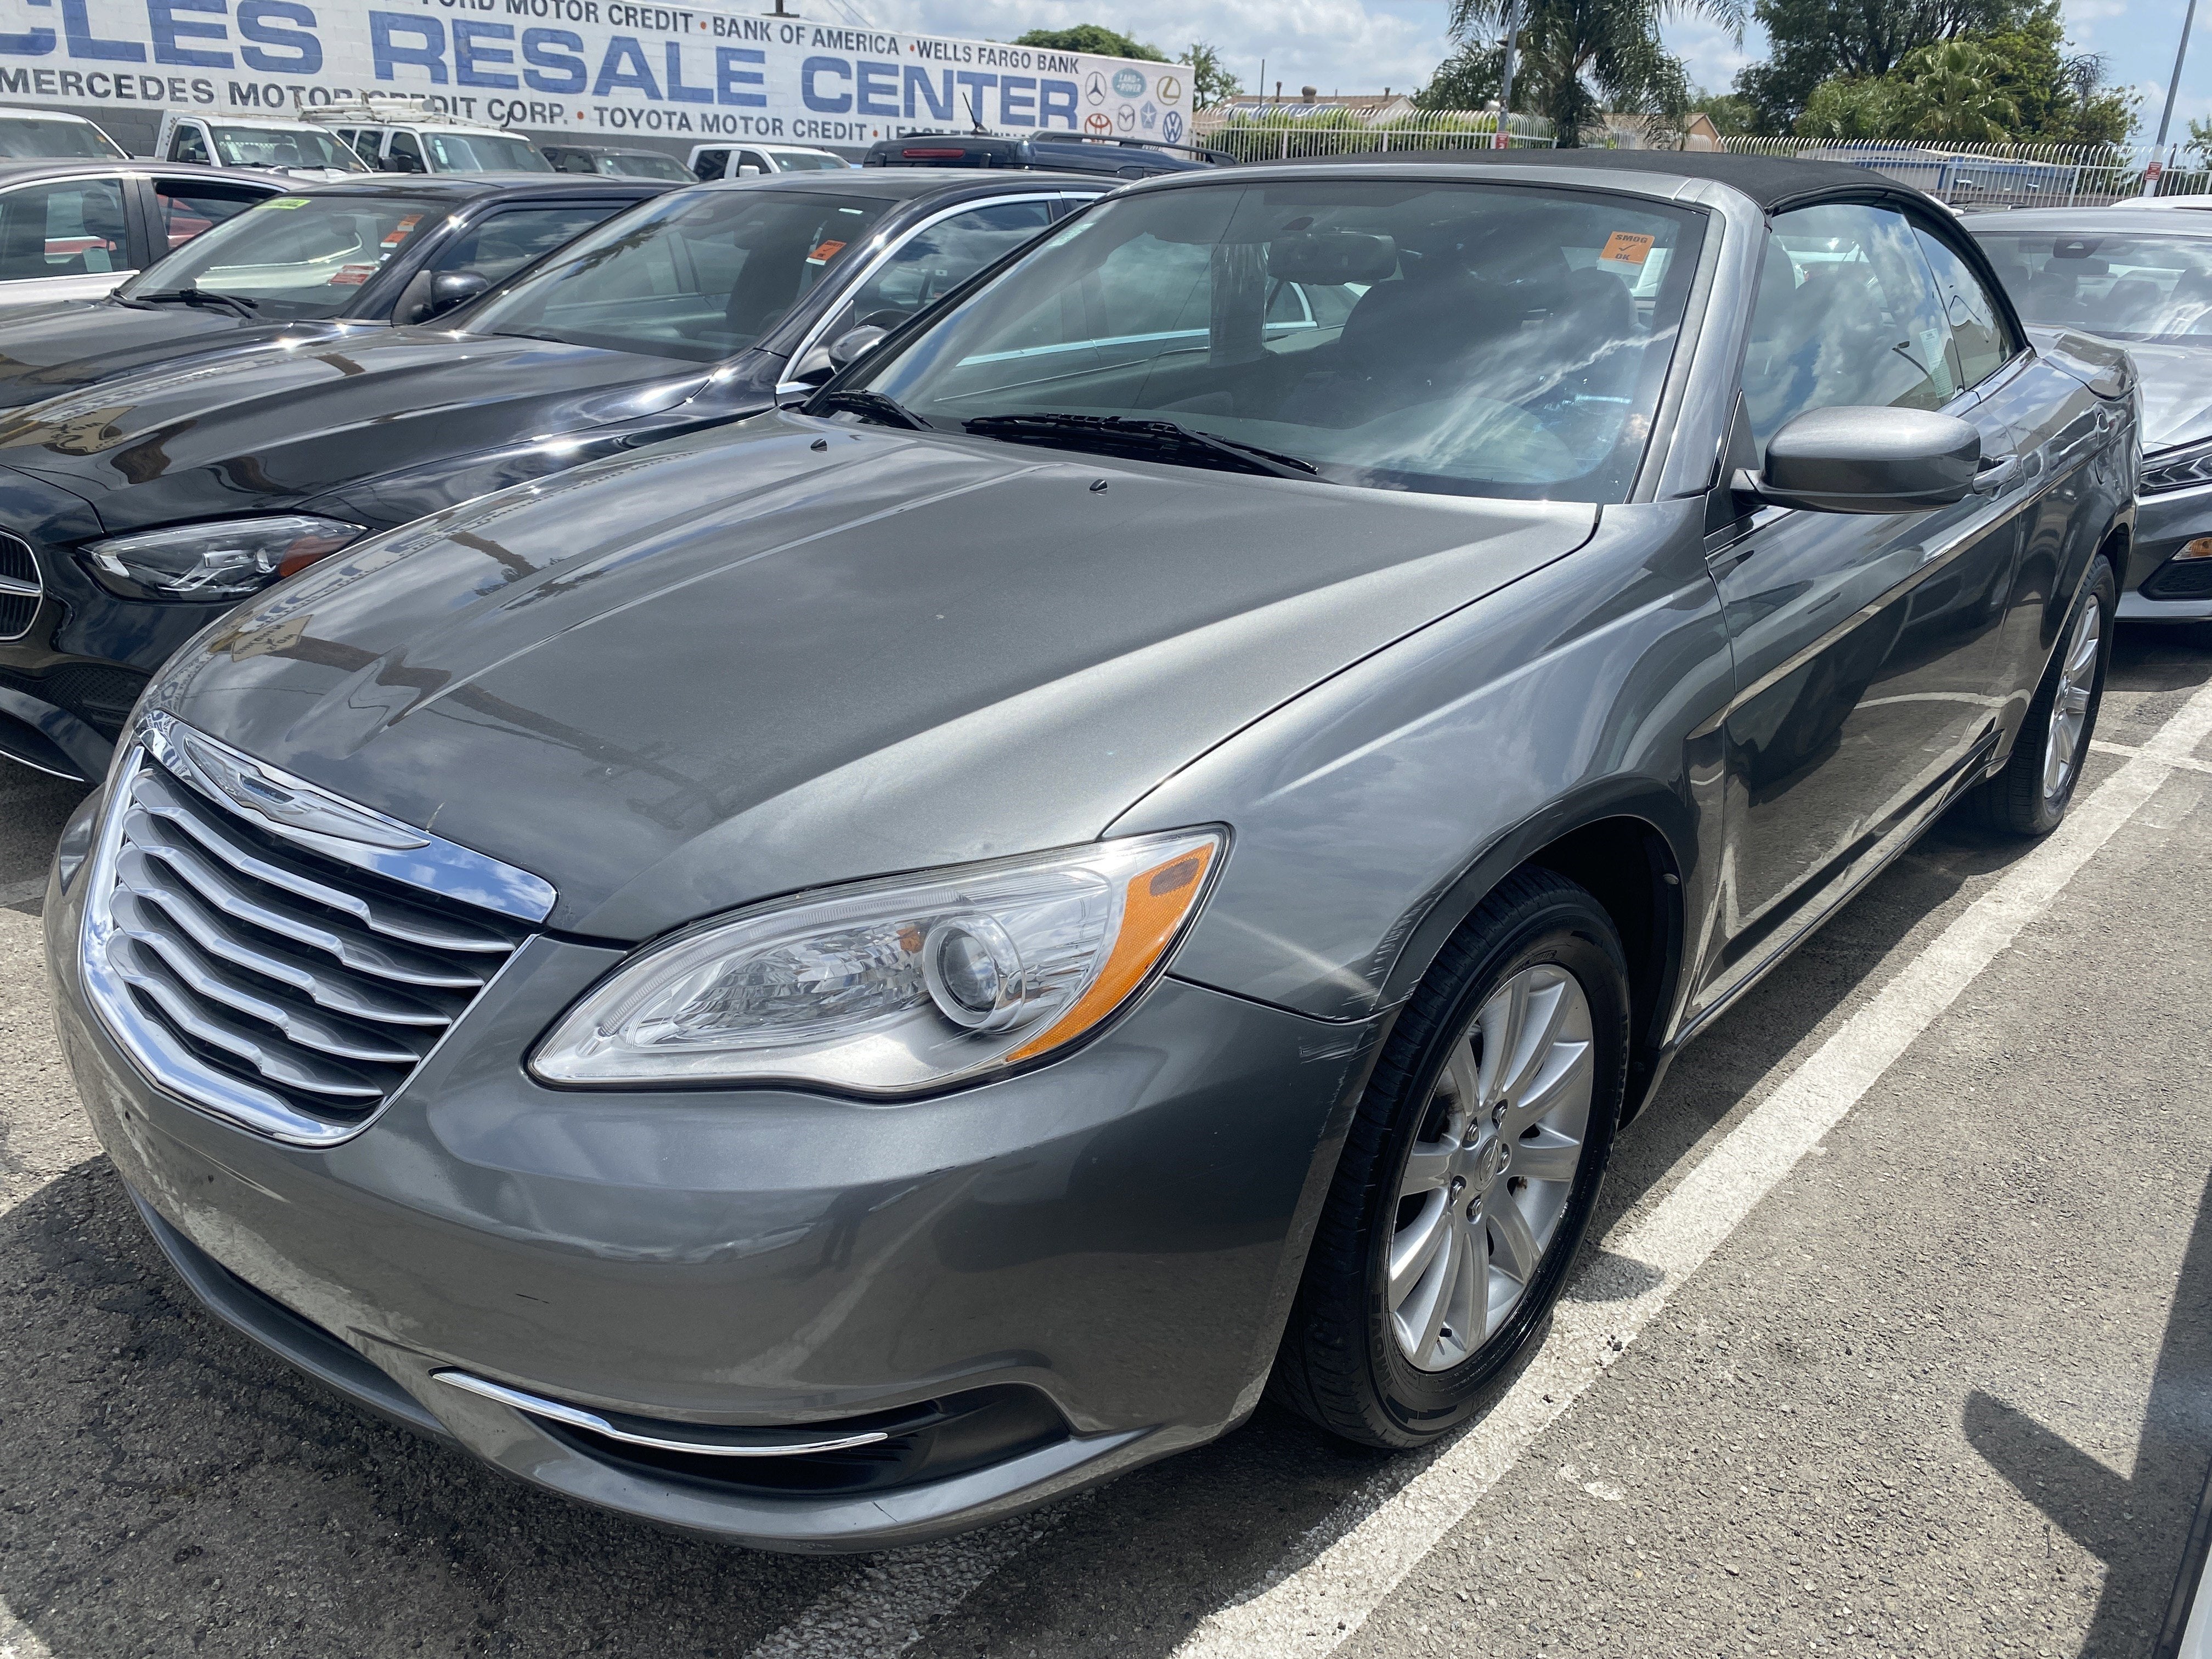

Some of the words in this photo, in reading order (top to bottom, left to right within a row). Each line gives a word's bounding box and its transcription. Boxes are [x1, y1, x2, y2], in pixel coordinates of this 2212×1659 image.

[368, 10, 767, 108] RESALE
[802, 56, 1078, 130] CENTER
[506, 0, 599, 23] MOTOR
[608, 4, 693, 33] CREDIT
[713, 16, 772, 42] BANK
[780, 24, 805, 45] OF
[811, 28, 900, 55] AMERICA
[916, 40, 971, 63] WELLS
[978, 47, 1031, 69] FARGO
[1037, 54, 1079, 75] BANK
[0, 67, 215, 104] MERCEDES
[487, 98, 568, 125] CORP.
[594, 106, 693, 132] TOYOTA
[701, 114, 783, 137] MOTOR
[793, 119, 867, 141] CREDIT
[1615, 234, 1648, 244] SMOG
